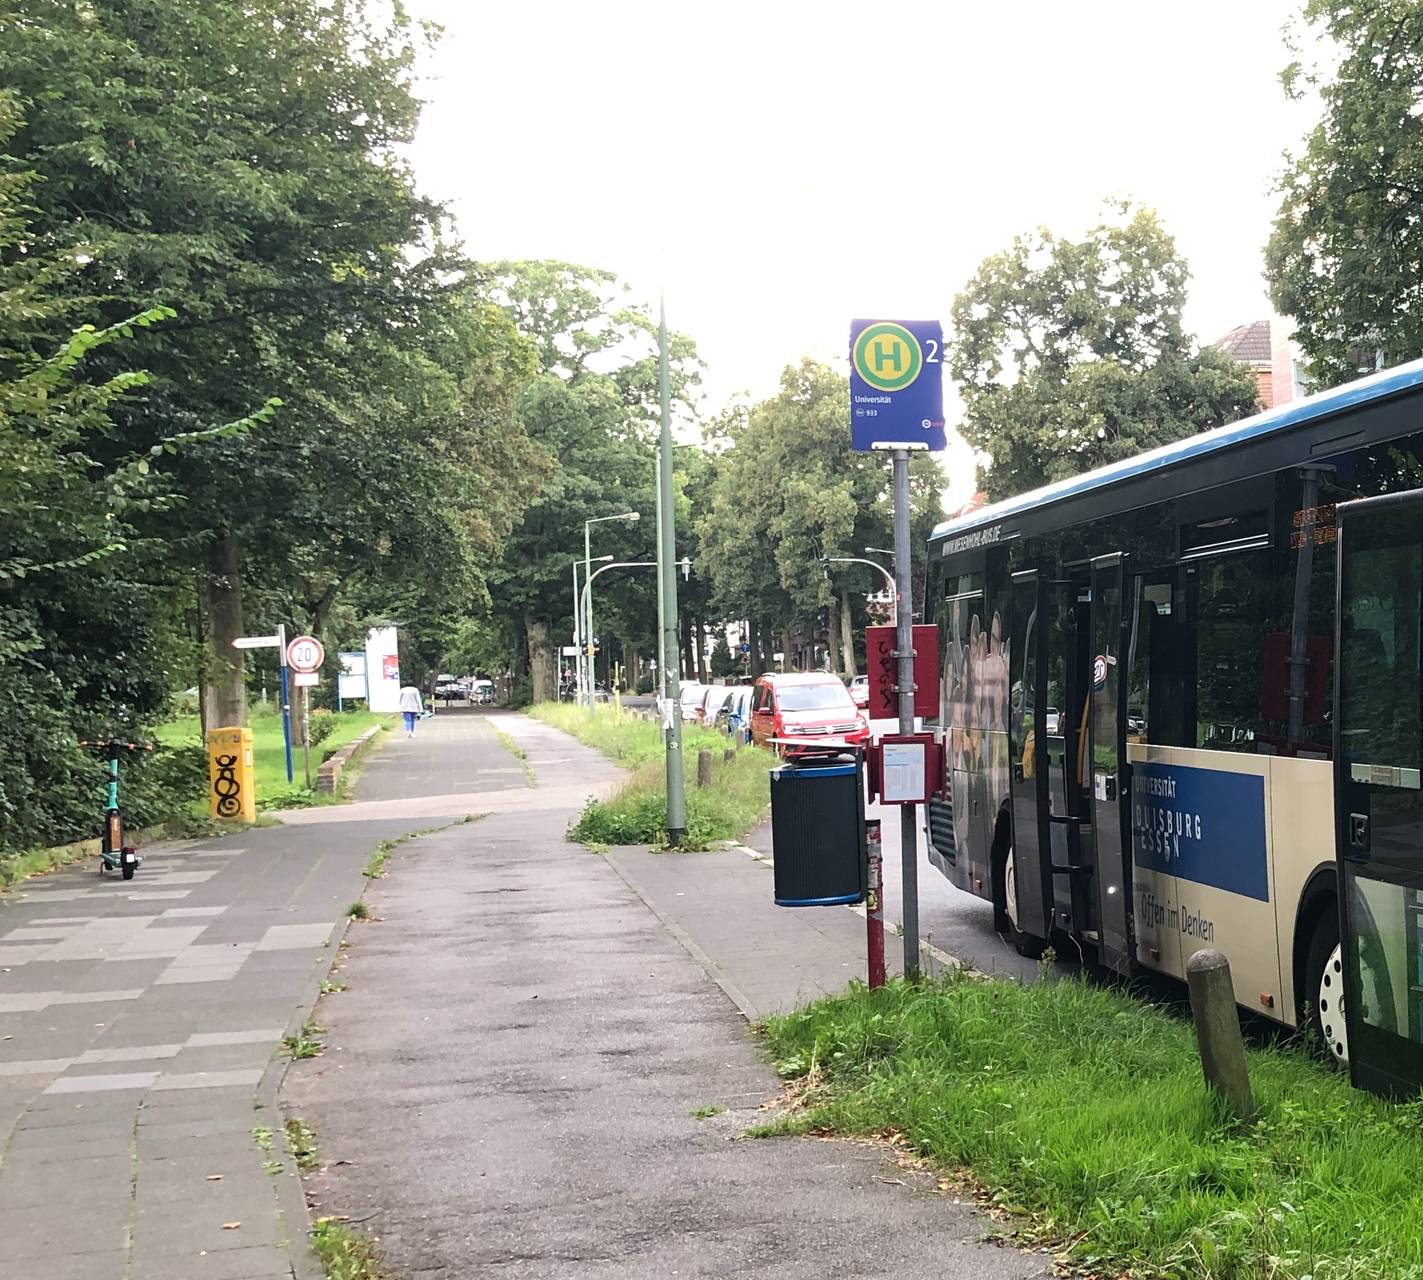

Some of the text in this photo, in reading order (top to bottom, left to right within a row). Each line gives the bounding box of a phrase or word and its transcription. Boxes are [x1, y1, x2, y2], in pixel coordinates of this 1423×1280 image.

[874, 341, 901, 371] H
[925, 339, 939, 363] 2
[854, 395, 892, 403] Universität
[297, 647, 311, 662] 20
[1135, 776, 1176, 798] UNIVERSITÄT
[1136, 804, 1201, 840] DUISBURG
[1141, 826, 1180, 858] ESSEN
[1141, 893, 1214, 943] Offen im Denken
